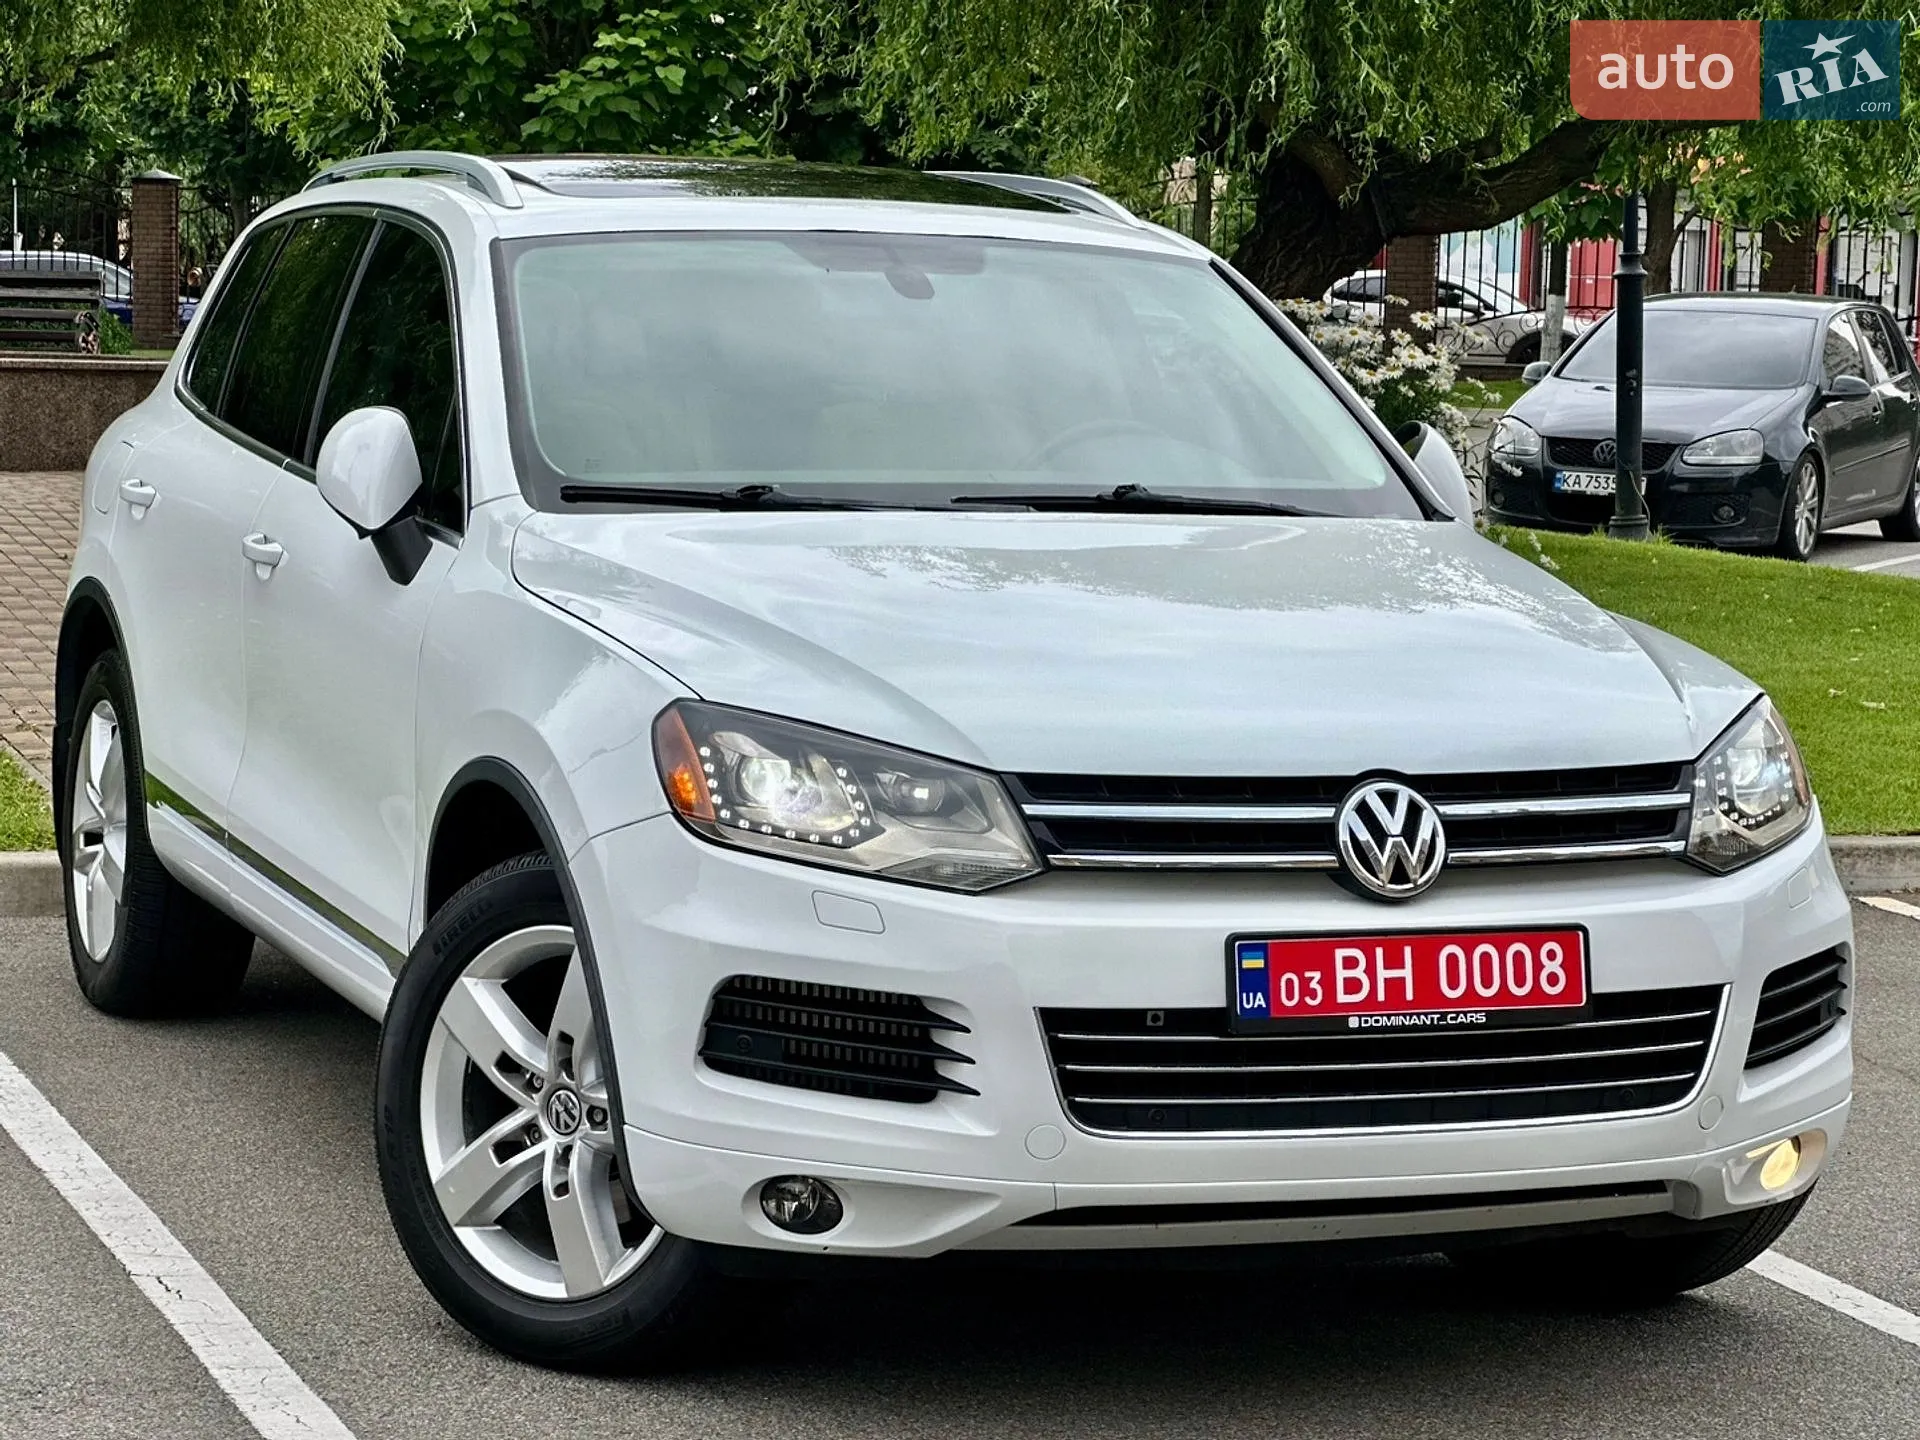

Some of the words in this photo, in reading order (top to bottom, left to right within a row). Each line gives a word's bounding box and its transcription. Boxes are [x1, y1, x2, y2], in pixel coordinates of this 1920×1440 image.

[1562, 473, 1581, 489] KA
[1242, 991, 1267, 1009] UA
[1279, 971, 1323, 1008] 03
[1334, 945, 1414, 1004] BH
[1438, 941, 1567, 1000] 0008
[1360, 1012, 1487, 1028] DOMINANT_CARS
